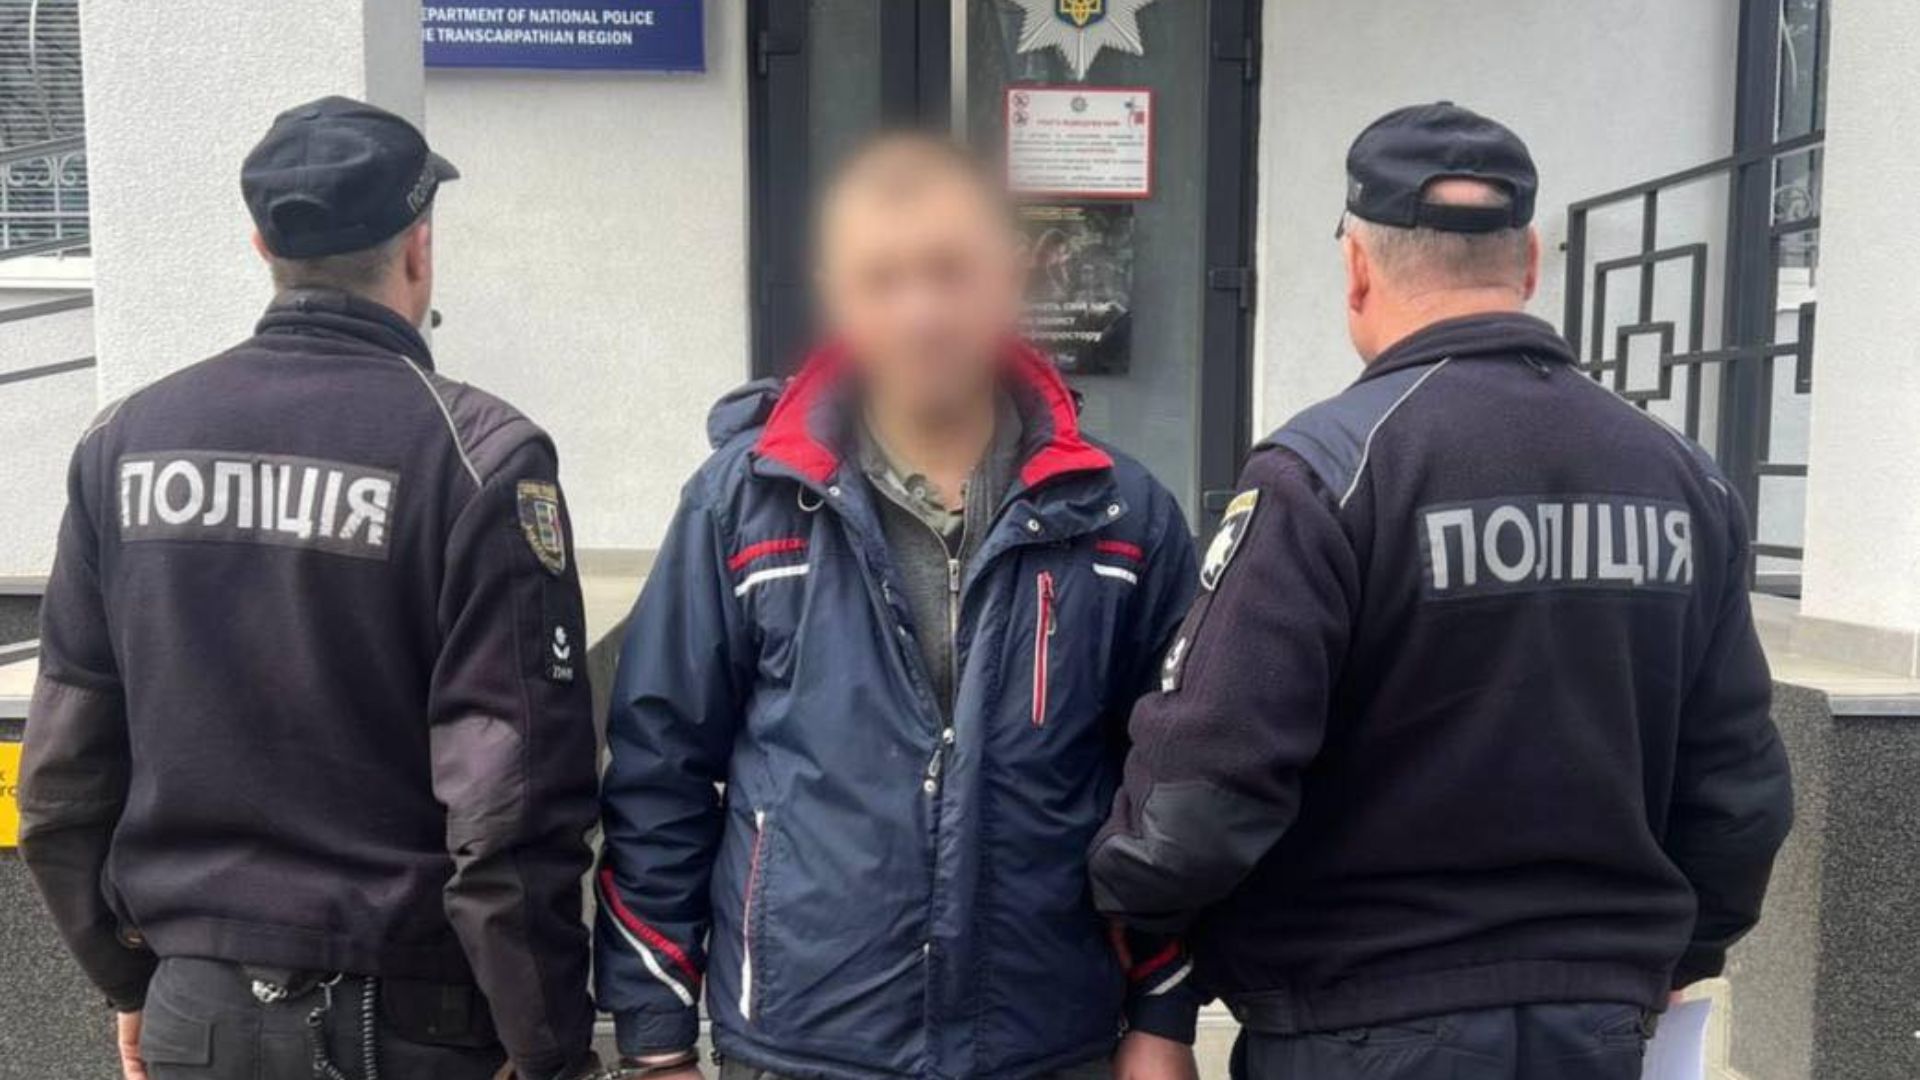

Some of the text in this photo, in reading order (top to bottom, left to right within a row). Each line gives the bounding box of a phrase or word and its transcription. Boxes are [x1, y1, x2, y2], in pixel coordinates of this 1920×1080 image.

[438, 28, 574, 44] TRANSCARPATHIAN
[578, 30, 633, 45] REGION
[507, 9, 525, 22] OF
[530, 9, 598, 23] NATIONAL
[602, 10, 654, 25] POLICE
[121, 459, 391, 545] ПОЛІЦІЯ
[1425, 503, 1693, 589] ПОЛІЦІЯ
